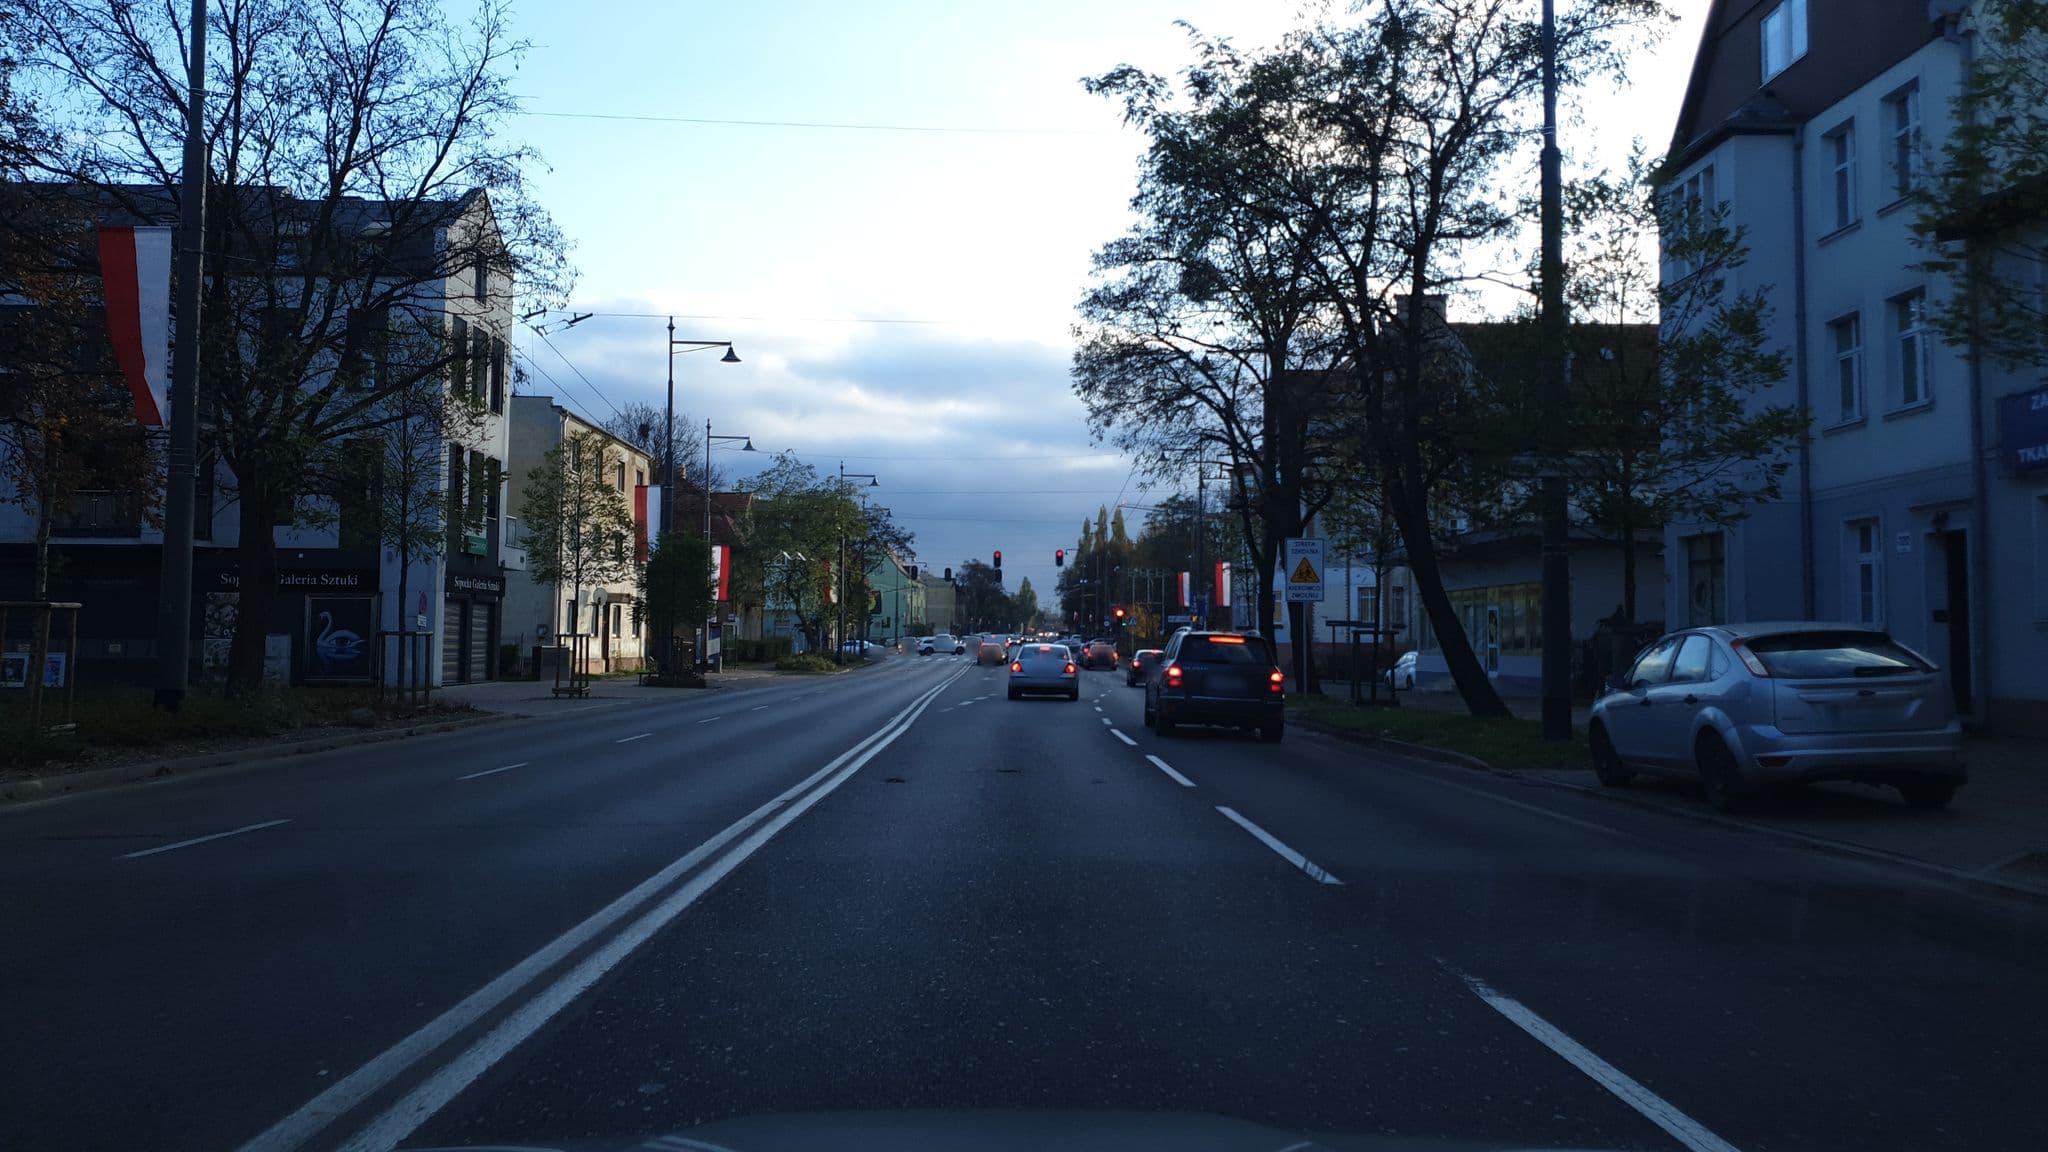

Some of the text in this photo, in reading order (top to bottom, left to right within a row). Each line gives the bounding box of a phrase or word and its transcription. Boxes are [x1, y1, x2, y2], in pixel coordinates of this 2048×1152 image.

[2031, 393, 2048, 411] ZA
[220, 574, 241, 588] Sop
[319, 573, 358, 586] Sztuki
